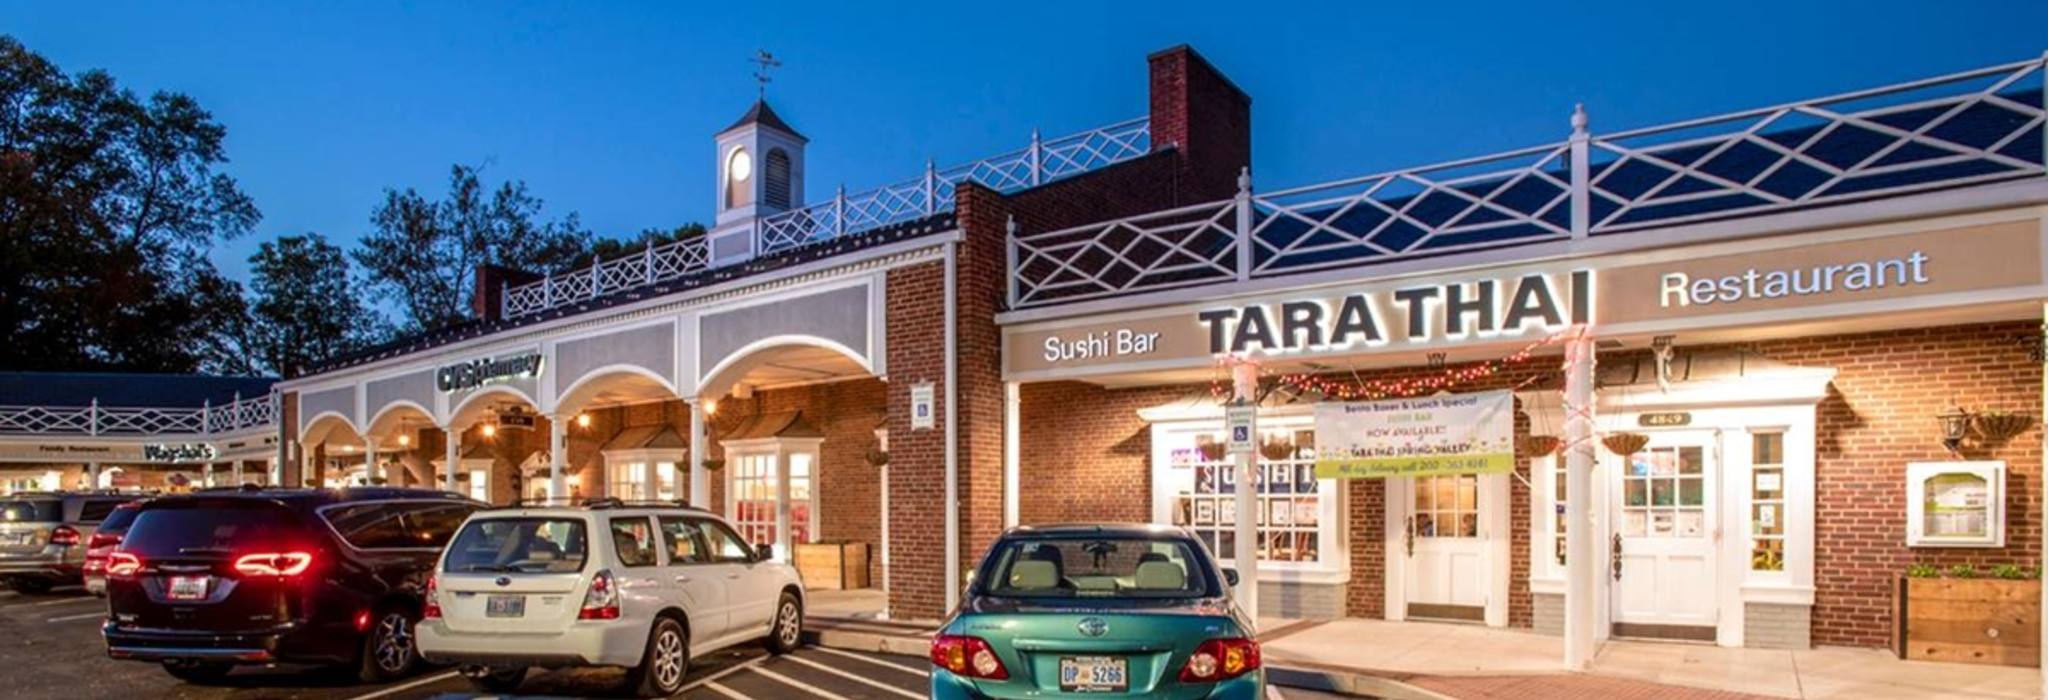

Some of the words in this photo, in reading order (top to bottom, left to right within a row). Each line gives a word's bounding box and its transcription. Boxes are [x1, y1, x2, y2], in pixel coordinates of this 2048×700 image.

[1660, 250, 1929, 307] Restaurant
[1198, 293, 1382, 354] TARA
[1394, 269, 1590, 338] THAI
[1044, 331, 1110, 362] Sushi
[1116, 328, 1161, 355] Bar
[1064, 665, 1080, 683] DP
